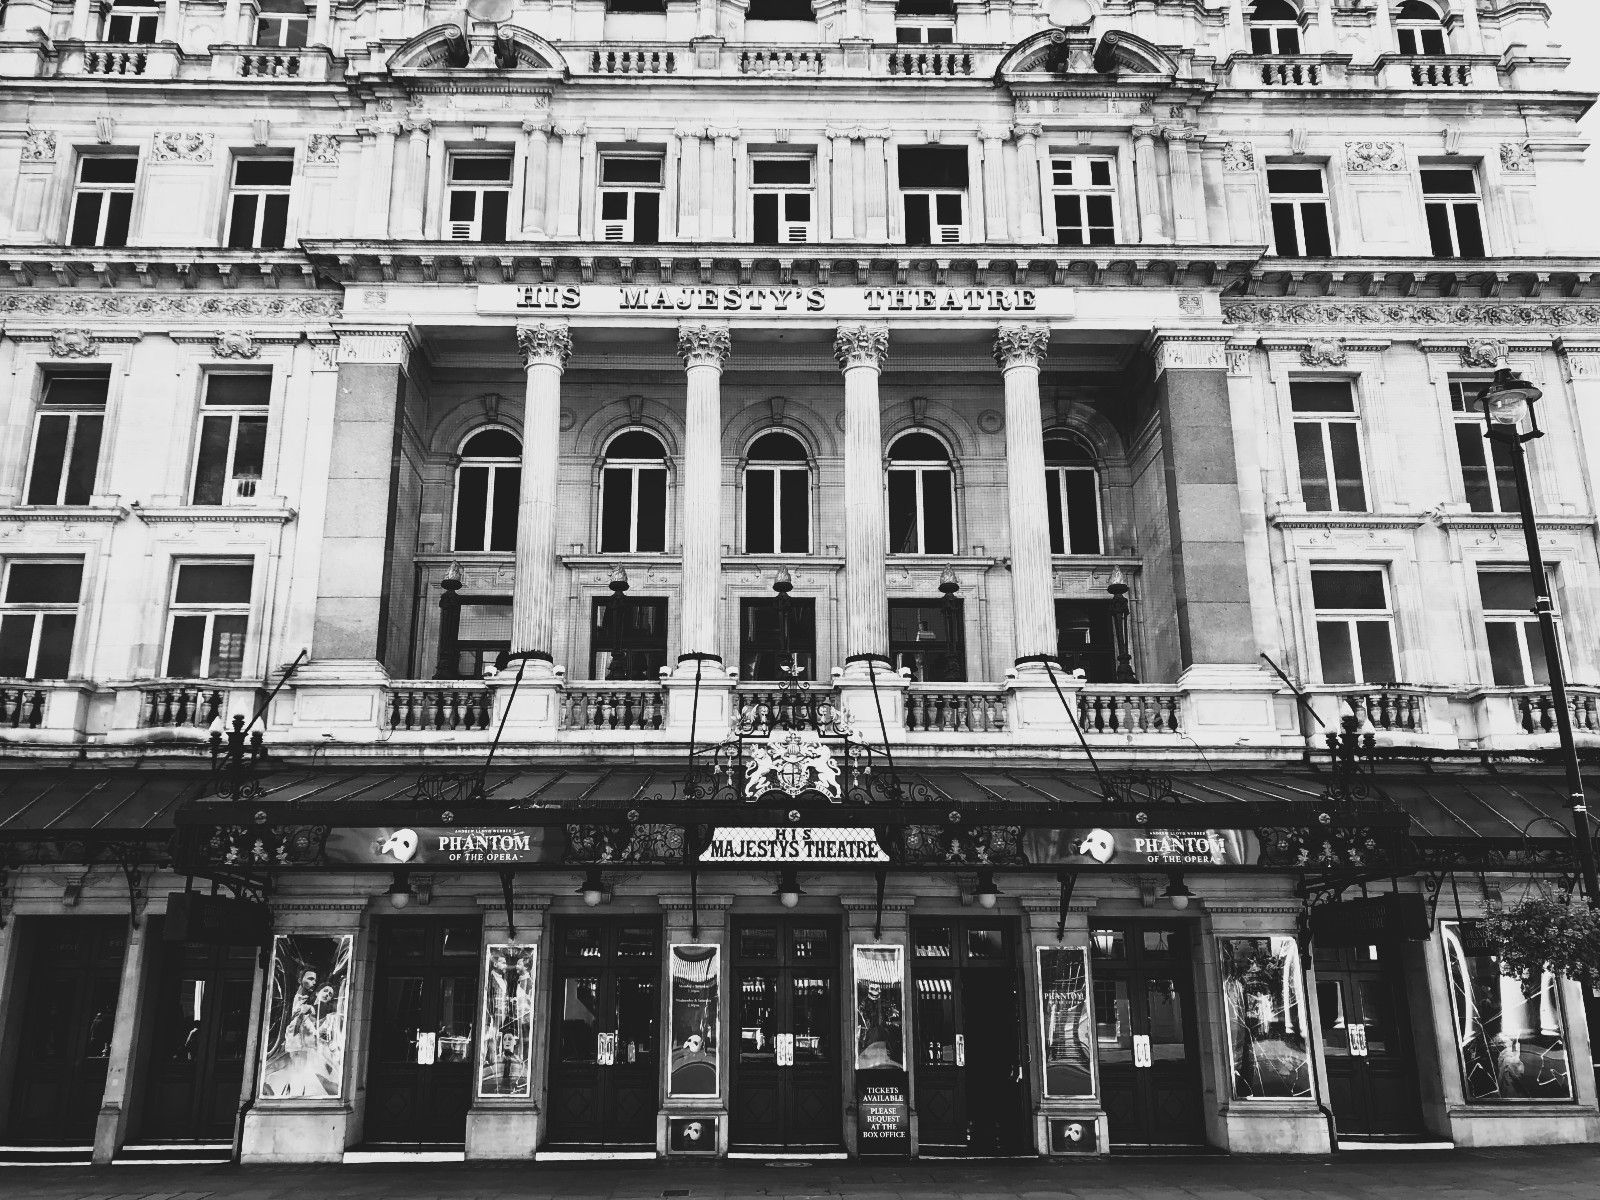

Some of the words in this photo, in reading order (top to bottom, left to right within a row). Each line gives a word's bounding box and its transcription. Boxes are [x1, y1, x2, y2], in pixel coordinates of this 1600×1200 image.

[517, 286, 580, 309] HIS
[619, 287, 826, 311] MAJESTY'S
[864, 288, 1036, 311] THEATRE
[775, 829, 812, 840] HIS
[438, 835, 531, 851] PHANTOM
[804, 840, 879, 858] THEATRE
[1134, 837, 1227, 853] PHANTOM
[449, 853, 462, 861] OF
[464, 853, 484, 861] THE
[486, 853, 518, 861] OPERA
[1147, 855, 1160, 863] OF
[1163, 855, 1182, 863] THE
[1184, 855, 1216, 863] OPERA
[867, 1115, 901, 1123] REQUEST
